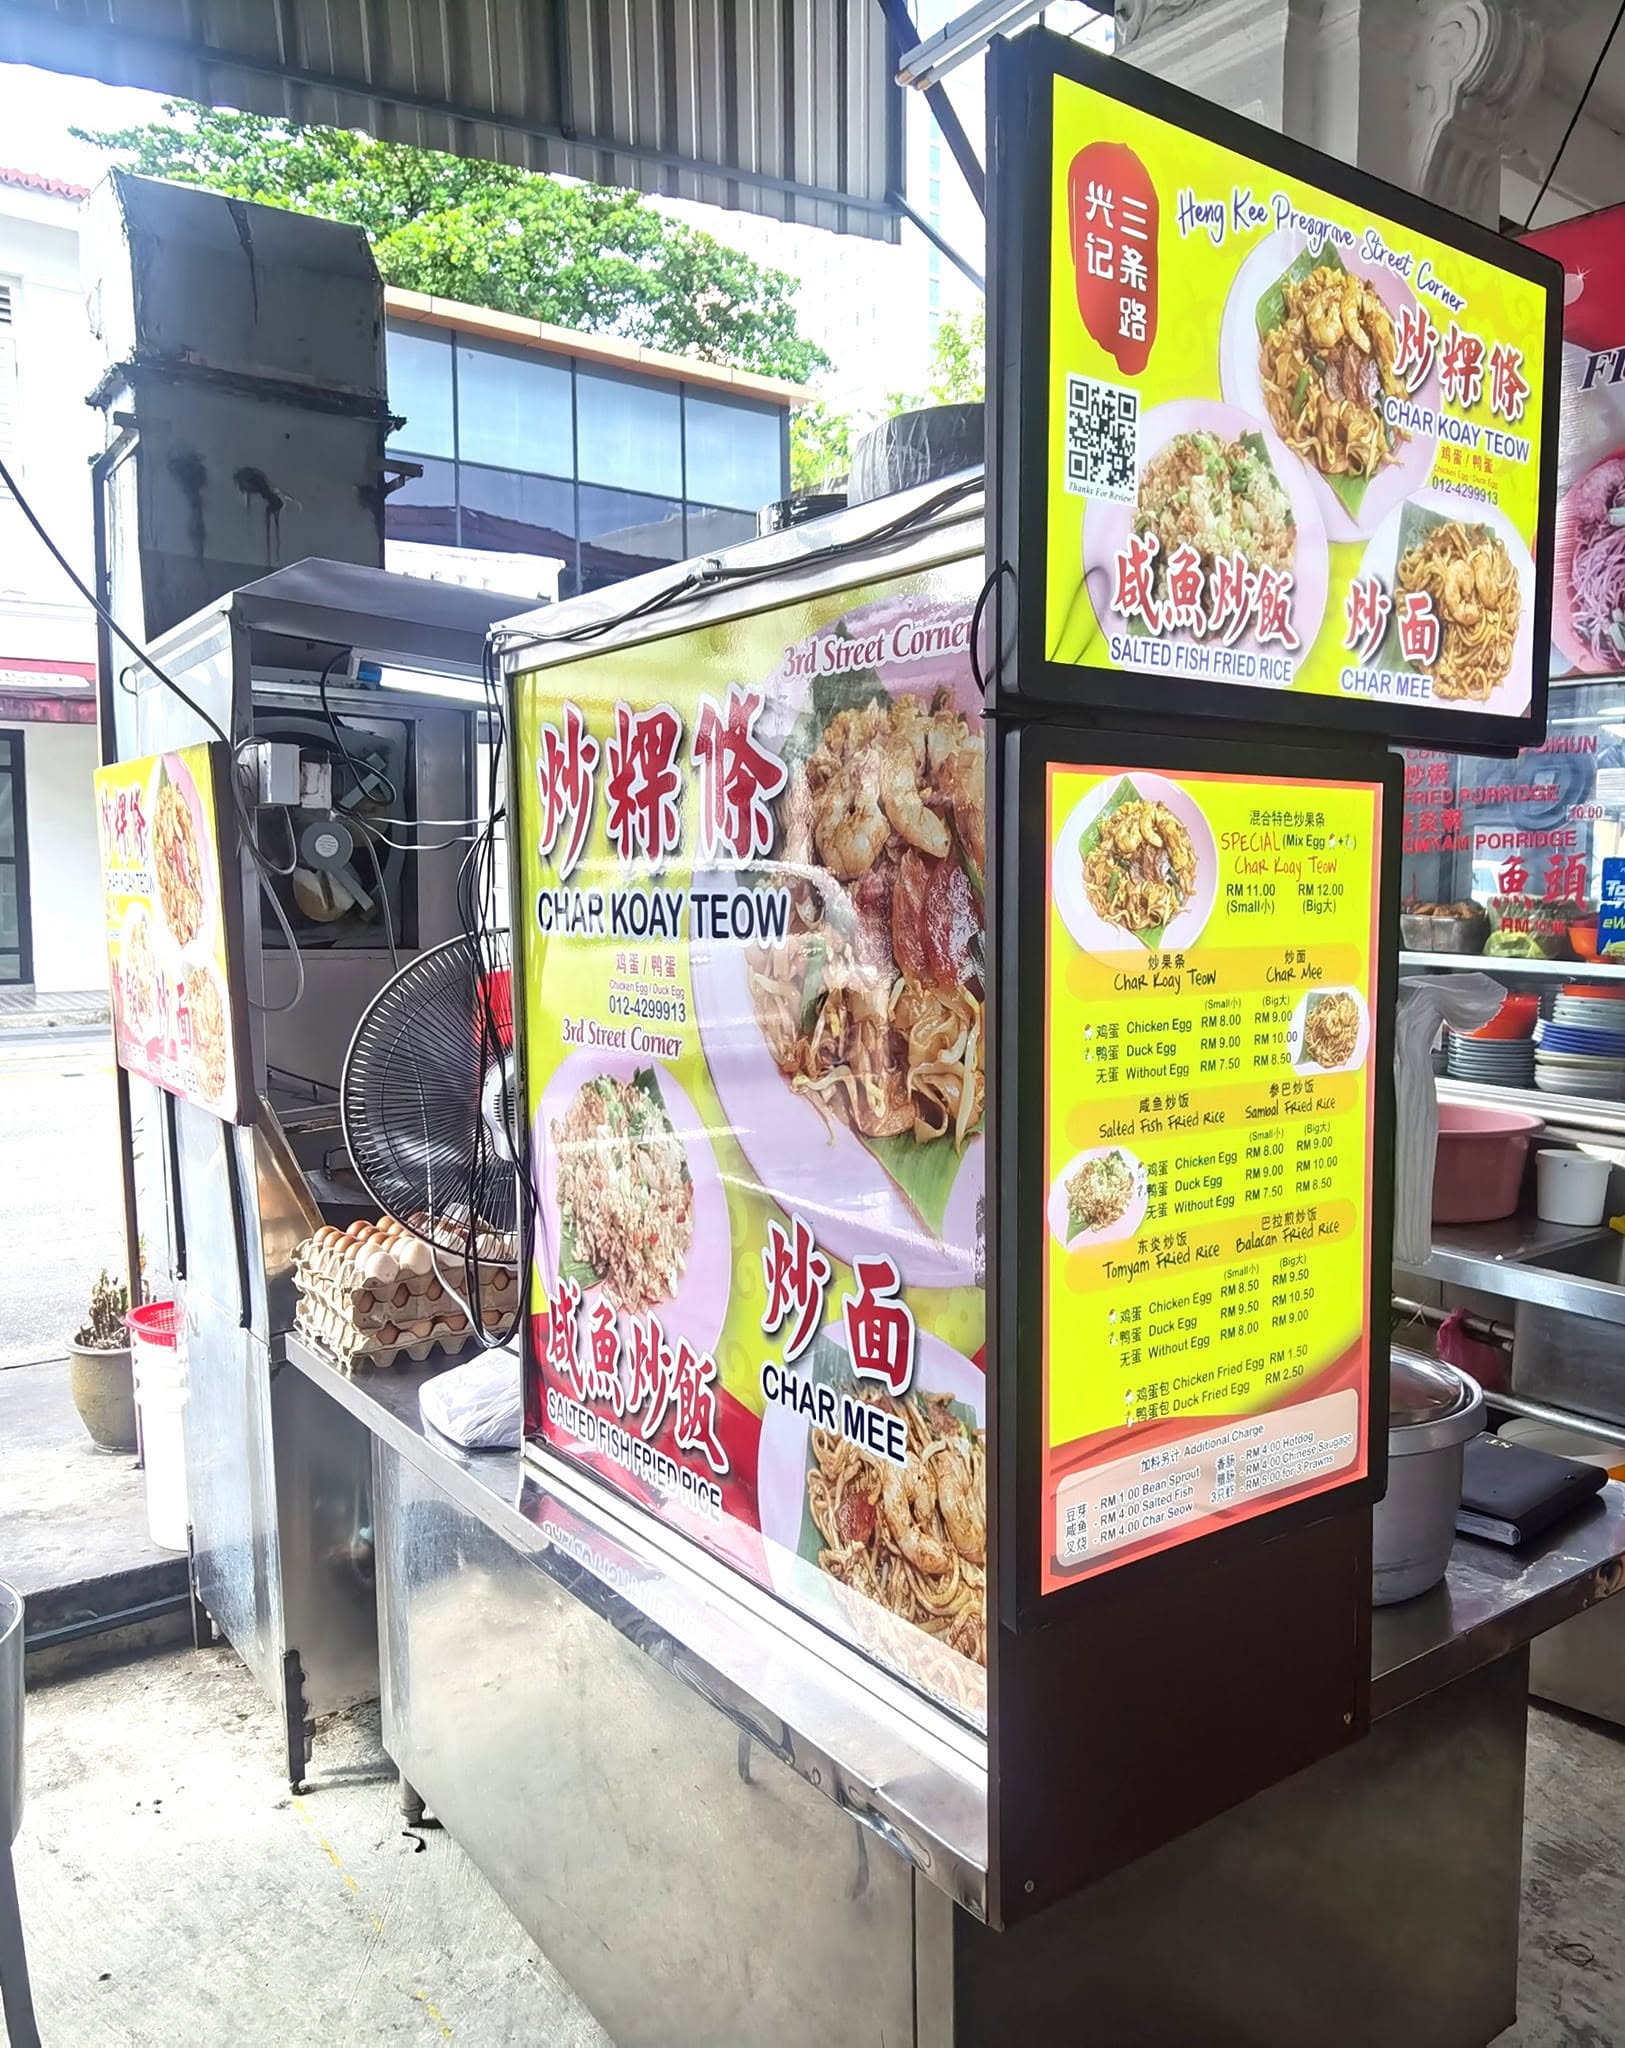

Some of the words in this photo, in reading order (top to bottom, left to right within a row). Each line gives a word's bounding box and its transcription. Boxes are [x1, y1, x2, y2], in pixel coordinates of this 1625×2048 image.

[1178, 190, 1225, 244] Heng
[1232, 188, 1268, 231] Kee
[1271, 194, 1354, 254] Presgrave
[1361, 230, 1412, 278] Street
[1417, 261, 1466, 312] Corner
[1118, 195, 1149, 342] 三条路
[1386, 399, 1434, 434] CHAR
[1438, 411, 1482, 448] KOAY
[1485, 430, 1530, 462] TEOW
[1068, 482, 1094, 495] Thanks
[1095, 487, 1108, 497] For
[1432, 476, 1499, 506] 012-4299913
[1346, 579, 1439, 663] 炒面
[784, 640, 817, 678] 3rd
[823, 633, 885, 672] Street
[1110, 636, 1172, 668] SALTED
[1174, 640, 1212, 672] FISH
[1213, 646, 1258, 678] FRIED
[1259, 651, 1292, 683] RICE
[1340, 669, 1394, 696] CHAR
[1396, 674, 1432, 700] MEE
[541, 690, 784, 872] 炒粿條
[1221, 831, 1281, 852] SPECIAL
[1306, 835, 1326, 850] Egg
[1475, 830, 1578, 851] PORRIDGE
[1226, 884, 1244, 896] RM
[1246, 884, 1276, 896] 11.00
[1298, 884, 1314, 896] RM
[1317, 883, 1344, 896] 12.00
[1493, 852, 1588, 913] 魚頭
[538, 891, 605, 935] CHAR
[610, 893, 684, 939] KOAY
[688, 893, 789, 943] TEOW
[1501, 916, 1530, 933] RM
[1284, 950, 1306, 964] 炒面
[635, 982, 648, 996] Egg
[671, 985, 685, 1001] Egg
[609, 995, 687, 1023] 012-4299913
[1254, 1012, 1270, 1024] RM
[1272, 1010, 1292, 1023] 9.00
[1096, 1022, 1120, 1039] 鸡蛋
[1126, 1021, 1169, 1034] Chicken
[1172, 1018, 1192, 1032] Egg
[1201, 1016, 1217, 1028] RM
[1219, 1014, 1241, 1027] 8.00
[562, 1018, 585, 1044] 3rd
[587, 1020, 626, 1050] Street
[630, 1026, 683, 1057] Corner
[1200, 1038, 1217, 1050] RM
[1219, 1036, 1241, 1049] 9.00
[1254, 1034, 1270, 1046] RM
[1272, 1031, 1298, 1044] 10.00
[1096, 1044, 1119, 1062] 鸭蛋
[1126, 1043, 1153, 1057] Duck
[1156, 1042, 1177, 1056] Egg
[1253, 1055, 1269, 1067] RM
[1271, 1052, 1292, 1065] 8.50
[1096, 1066, 1119, 1084] 无蛋
[1126, 1065, 1167, 1080] Without
[1169, 1063, 1190, 1077] Egg
[1200, 1060, 1216, 1072] RM
[1219, 1058, 1241, 1070] 7.50
[1139, 1093, 1190, 1114] 咸鱼炒饭
[1140, 1117, 1163, 1134] Fish
[1246, 1146, 1261, 1159] RM
[1263, 1143, 1284, 1156] 8.00
[1296, 1139, 1311, 1152] RM
[1313, 1136, 1333, 1149] 9.00
[1175, 1154, 1216, 1170] Chicken
[1218, 1151, 1238, 1165] Egg
[763, 1221, 911, 1388] 炒面
[1172, 1371, 1215, 1391] Chicken
[1217, 1361, 1243, 1379] Fried
[1245, 1357, 1265, 1372] Egg
[1270, 1350, 1285, 1364] RM
[1288, 1344, 1308, 1359] 1.50
[1173, 1394, 1199, 1412] Duck
[1202, 1386, 1228, 1405] Fried
[1230, 1381, 1250, 1396] Egg
[1265, 1372, 1281, 1385] RM
[1283, 1364, 1304, 1381] 2.50
[762, 1364, 835, 1429] CHAR
[844, 1408, 907, 1462] MEE
[1184, 1433, 1233, 1457] Additional
[1231, 1425, 1264, 1441] Charge
[548, 1390, 596, 1443] SALTED
[599, 1420, 631, 1467] FISH
[634, 1442, 678, 1492] FRIED
[682, 1470, 721, 1521] RICE
[1100, 1495, 1117, 1508] RM
[1142, 1481, 1167, 1496] Bean
[1168, 1467, 1200, 1487] Sprout
